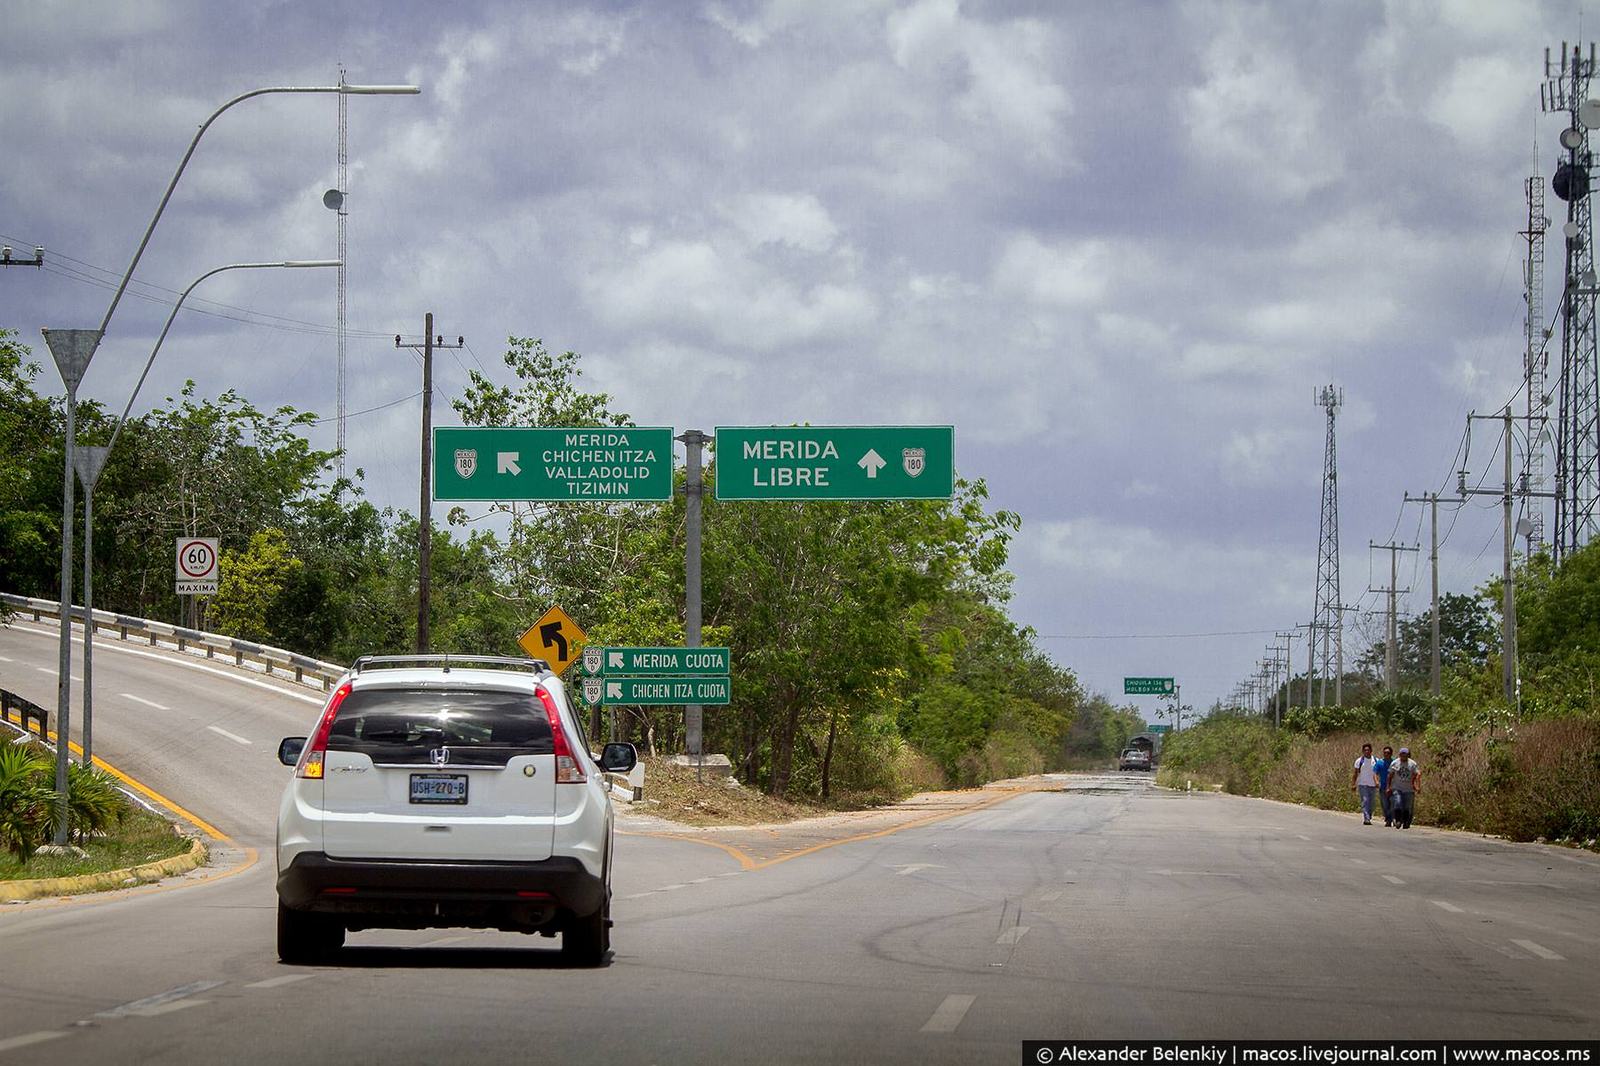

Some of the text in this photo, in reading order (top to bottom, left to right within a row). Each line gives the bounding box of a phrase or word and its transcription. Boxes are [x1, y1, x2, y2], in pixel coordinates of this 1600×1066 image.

[565, 434, 630, 447] MERIDA
[542, 450, 657, 463] CHICHEN ITZA
[743, 440, 839, 460] MERIDA
[460, 459, 472, 468] 180
[907, 459, 921, 469] 180
[545, 466, 650, 479] VALLADOLID
[753, 467, 830, 487] LIBRE
[566, 482, 629, 495] TIZIMIN
[189, 549, 207, 564] 60
[587, 657, 599, 665] 180
[633, 654, 724, 668] MERIDA CUOTA
[587, 687, 599, 695] 180
[632, 683, 726, 698] CHICHEN ITZA CUOTA
[412, 781, 465, 795] USH-270-B
